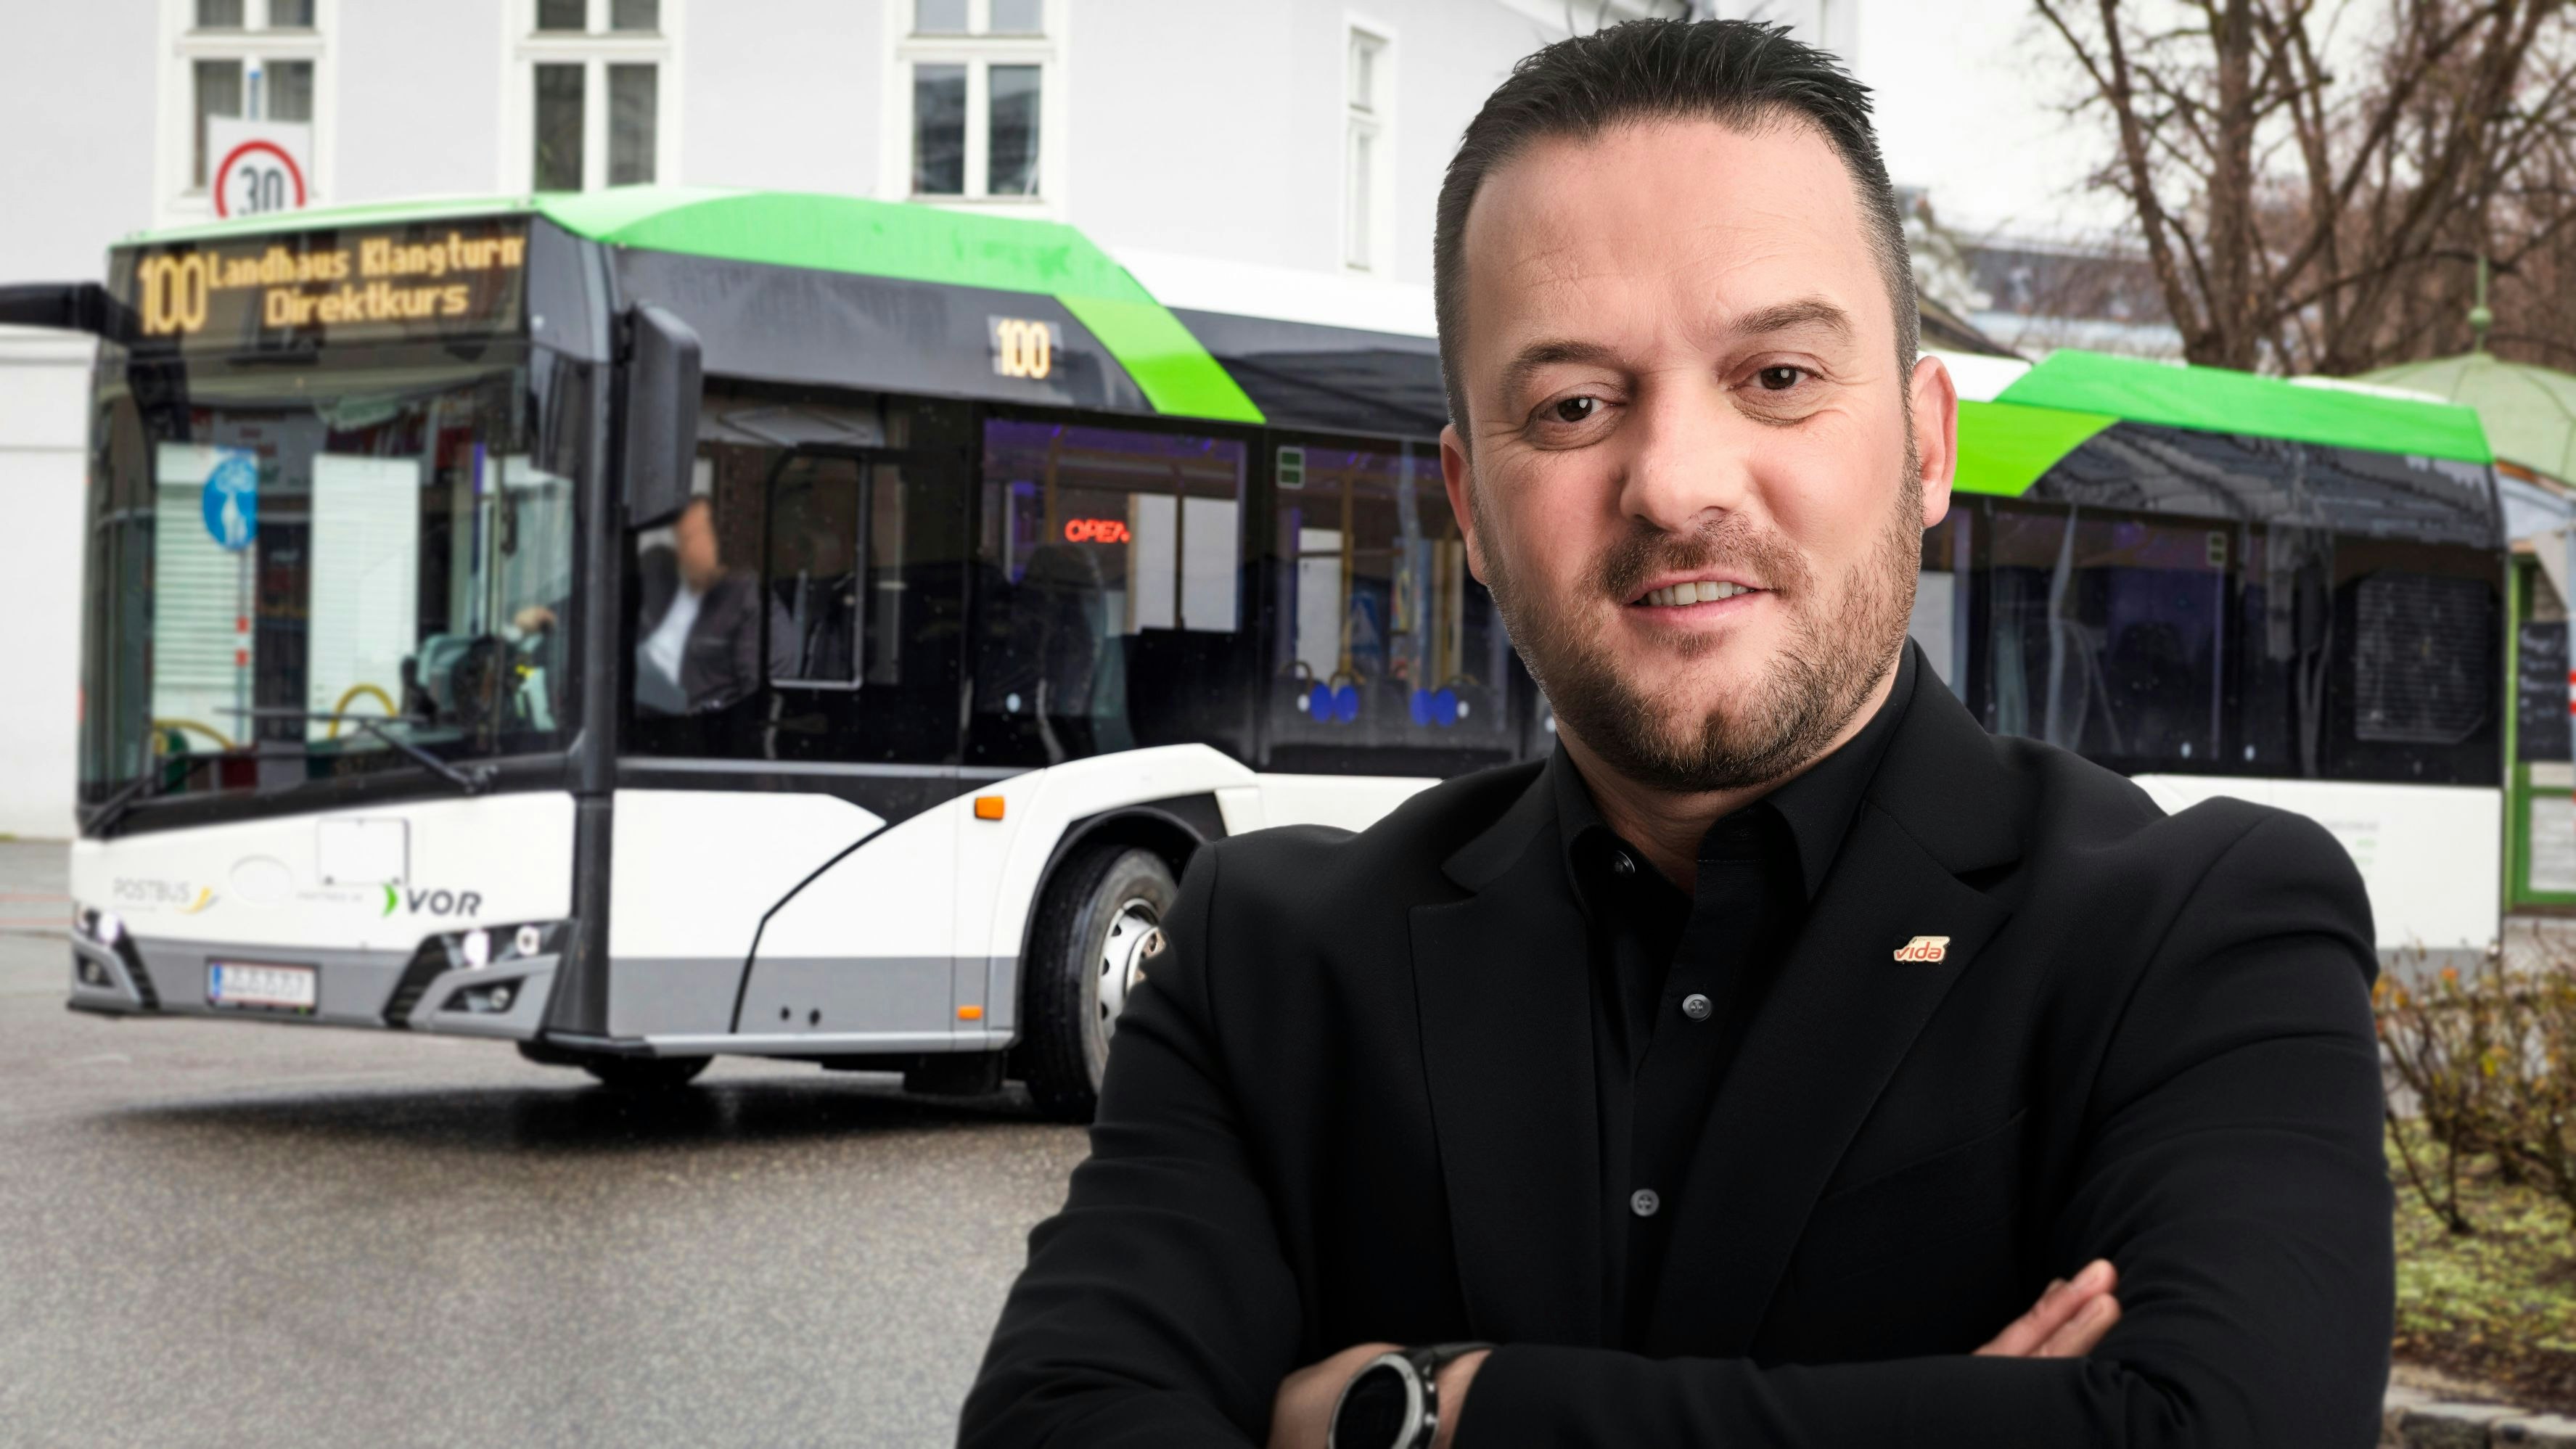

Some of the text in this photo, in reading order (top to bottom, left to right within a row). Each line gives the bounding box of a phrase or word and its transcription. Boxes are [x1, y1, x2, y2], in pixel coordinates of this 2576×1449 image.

[239, 166, 284, 213] 30
[139, 254, 206, 334] 100
[208, 245, 350, 287] Landhaus
[266, 284, 469, 327] Direktkurs
[997, 319, 1051, 379] 100
[113, 877, 191, 903] POSTBUS
[406, 888, 482, 916] VOR
[1896, 942, 1942, 959] vida
